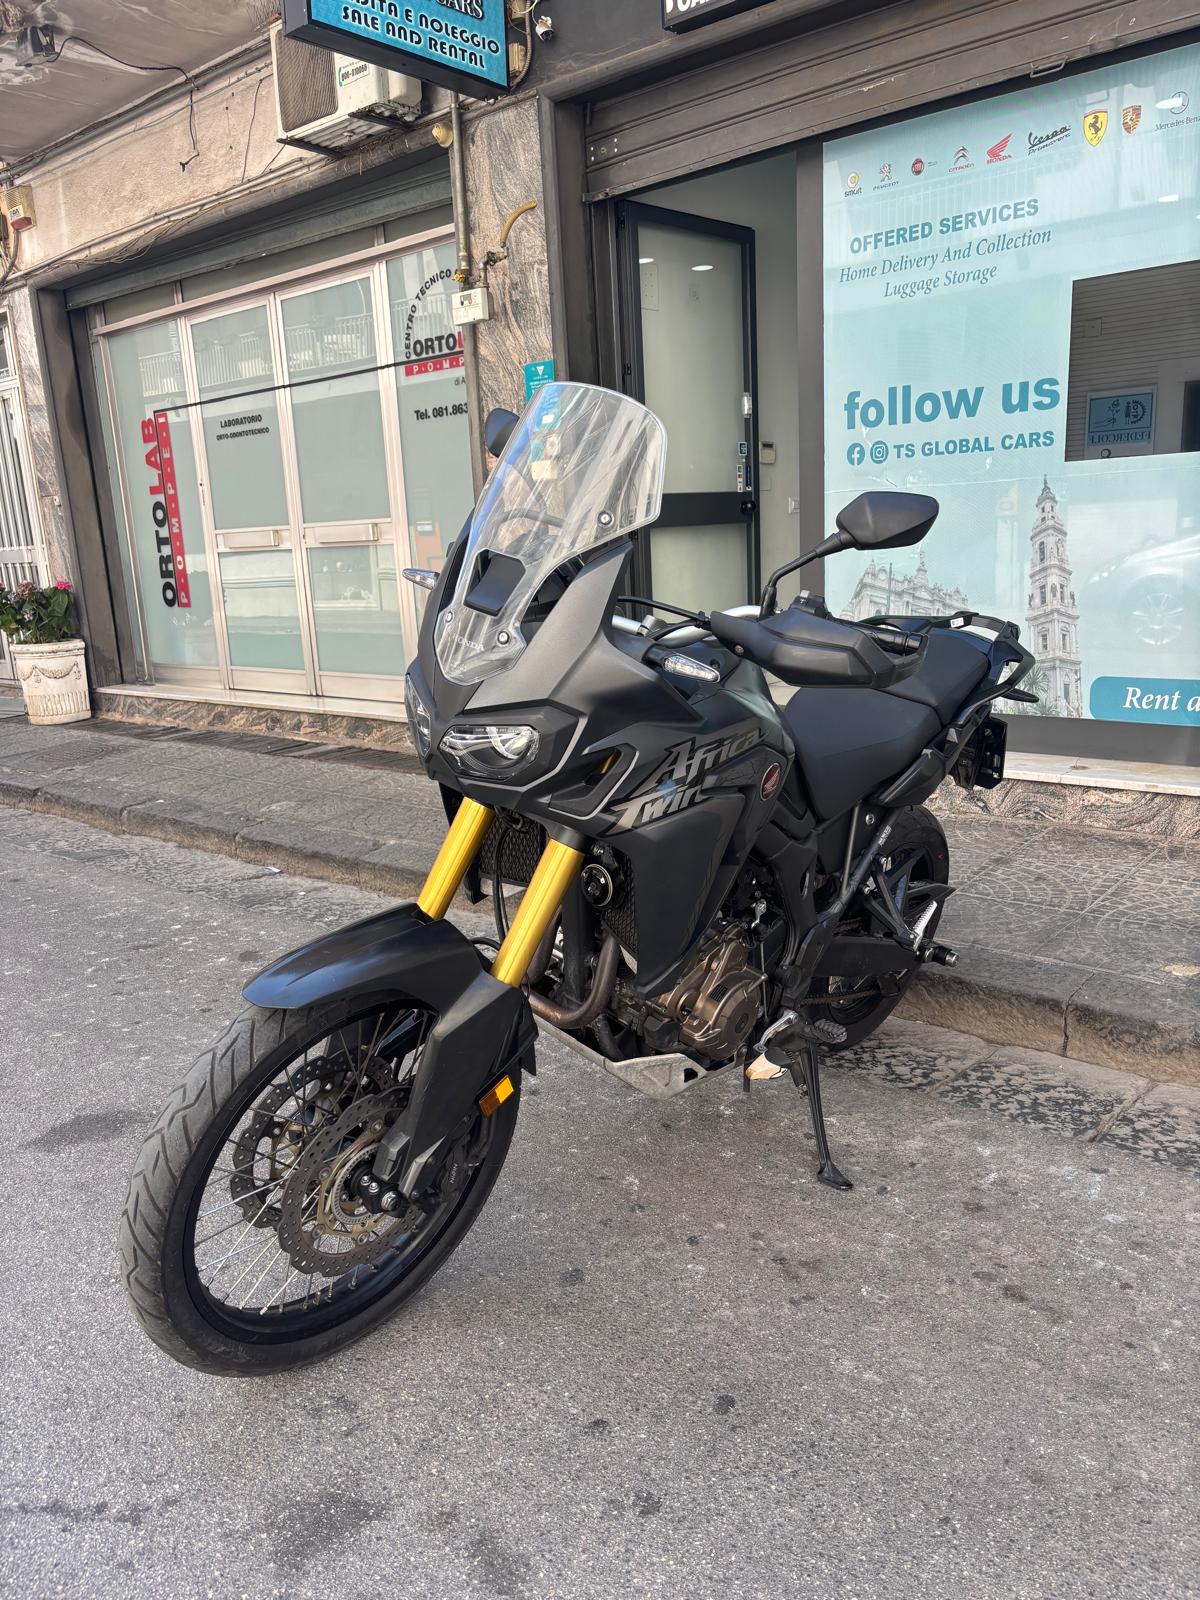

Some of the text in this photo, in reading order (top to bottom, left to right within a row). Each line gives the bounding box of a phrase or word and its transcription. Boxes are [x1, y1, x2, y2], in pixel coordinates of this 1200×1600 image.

[342, 6, 485, 69] SALE AND RENTAL
[404, 8, 413, 23] E
[418, 13, 500, 54] NOLEGGIO
[1028, 125, 1071, 147] Vespa
[986, 154, 1013, 165] HONDA
[844, 187, 862, 197] smart
[850, 198, 1039, 254] OFFERED SERVICES
[839, 227, 1052, 283] Home Delivery And Collection
[885, 264, 998, 299] Luggage Storage
[404, 268, 451, 359] CENTRO TECNICO
[220, 414, 262, 429] LABORATORIO
[414, 408, 430, 421] Tel.
[844, 377, 1060, 430] follow us
[216, 427, 270, 441] ORTO-ODONTOTECNICO
[894, 430, 1055, 459] TS GLOBAL CARS
[141, 417, 177, 607] ORTOLAB
[1122, 686, 1200, 712] Rent a
[609, 727, 766, 798] Africa
[606, 778, 716, 834] Twin
